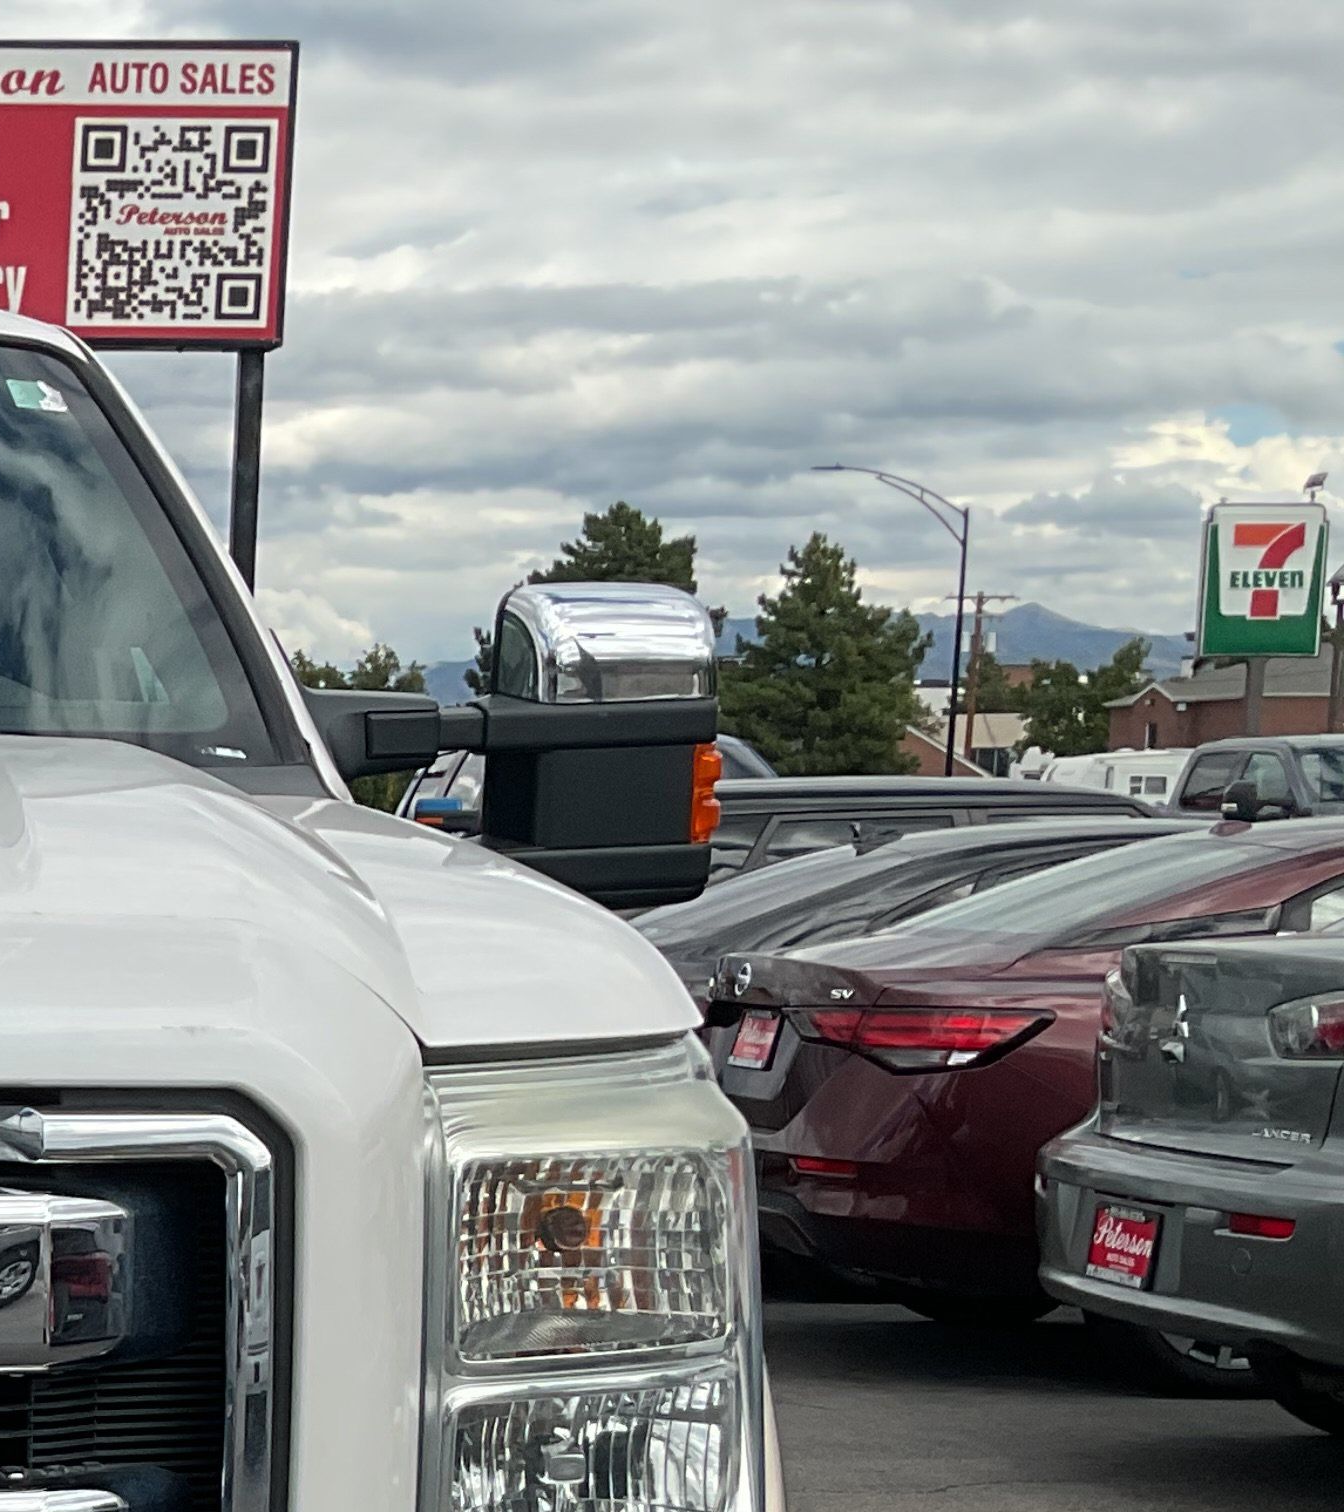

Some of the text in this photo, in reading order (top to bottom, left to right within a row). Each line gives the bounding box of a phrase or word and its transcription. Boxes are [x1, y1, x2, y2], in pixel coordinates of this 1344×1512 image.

[87, 62, 169, 95] AUTO
[180, 62, 276, 96] SALES
[115, 203, 229, 226] Peterson
[1232, 521, 1307, 618] 7
[829, 987, 856, 1000] SV
[1093, 1215, 1155, 1258] Peterson
